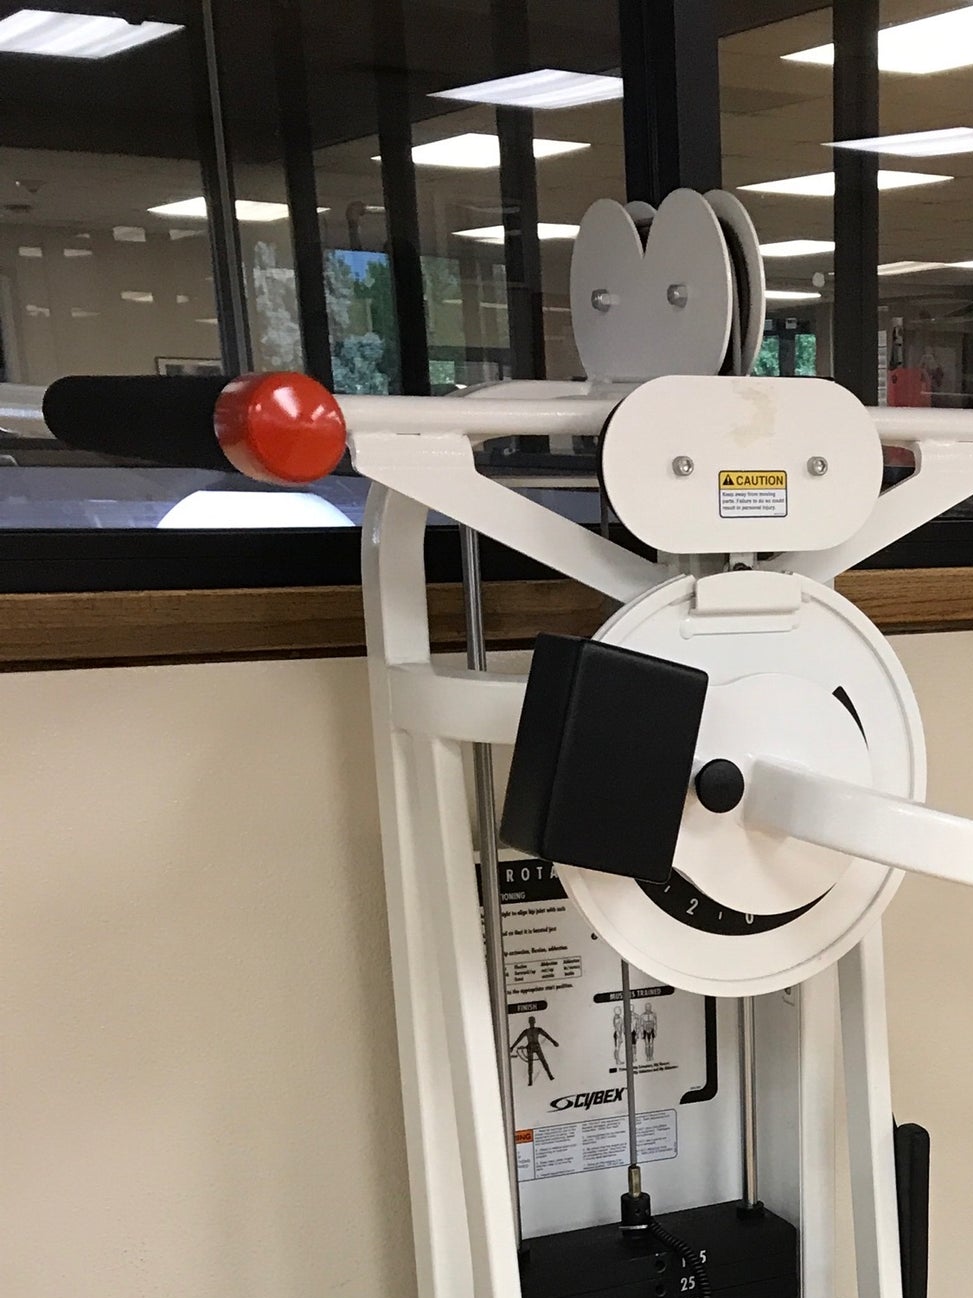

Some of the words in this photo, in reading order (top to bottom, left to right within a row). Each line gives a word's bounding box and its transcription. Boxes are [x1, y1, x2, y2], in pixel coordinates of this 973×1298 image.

[736, 475, 784, 486] CAUTION
[686, 898, 699, 915] 2
[636, 988, 662, 998] TRAINED
[517, 1003, 538, 1012] FINISH
[573, 1088, 626, 1110] CYBEX
[680, 1276, 696, 1292] 25
